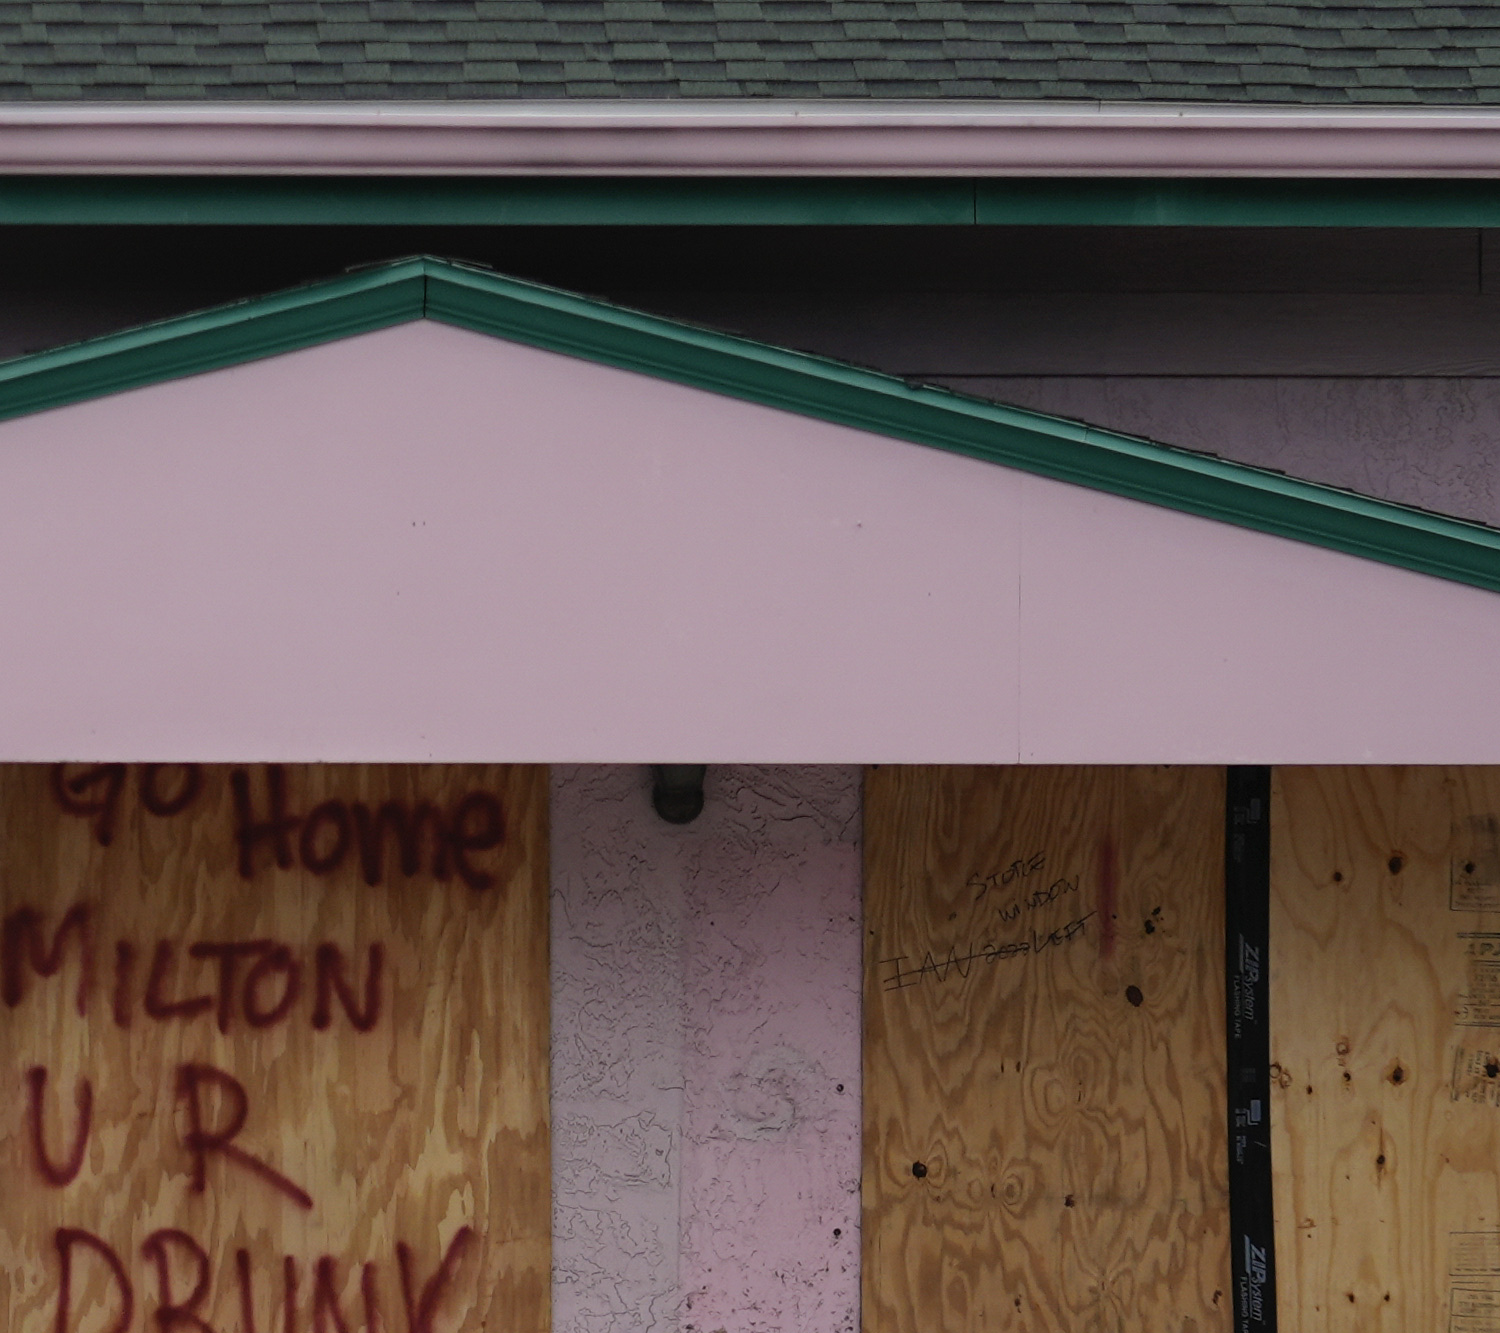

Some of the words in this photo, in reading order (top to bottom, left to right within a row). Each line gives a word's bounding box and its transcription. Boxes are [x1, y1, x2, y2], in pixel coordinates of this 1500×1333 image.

[1, 901, 386, 1037] MILTON
[26, 1065, 93, 1189] U
[175, 1062, 314, 1211] R
